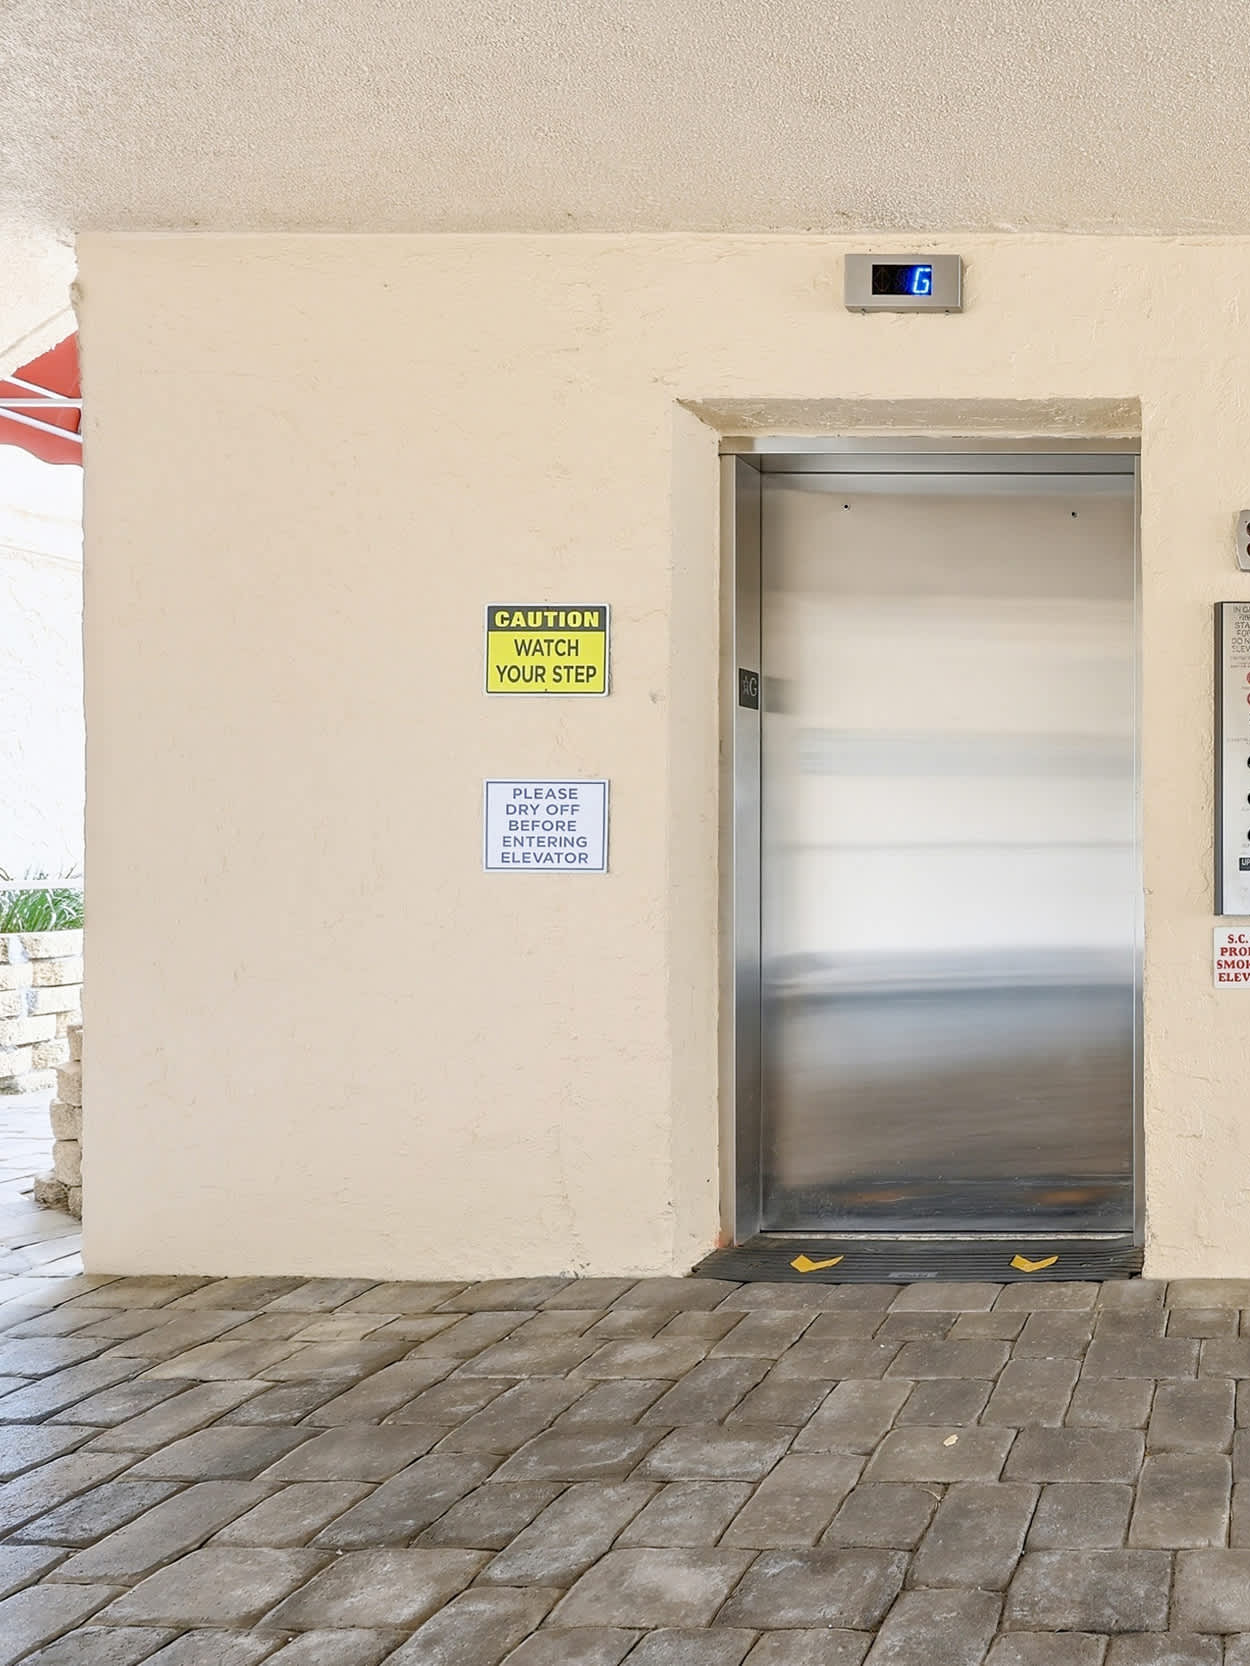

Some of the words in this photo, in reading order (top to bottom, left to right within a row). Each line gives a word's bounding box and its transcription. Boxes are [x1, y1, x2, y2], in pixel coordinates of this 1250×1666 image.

[912, 267, 931, 293] G
[495, 611, 599, 628] CAUTION
[514, 638, 579, 657] WATCH
[1231, 637, 1243, 645] DO
[496, 665, 546, 683] YOUR
[552, 665, 597, 683] STEP
[512, 787, 579, 800] PLEASE
[505, 803, 541, 816] DRY
[545, 803, 581, 816] OFF
[508, 819, 577, 832] BEFORE
[502, 835, 588, 848] ENTERING
[501, 851, 589, 864] ELEVATOR
[1227, 933, 1249, 944] S.C.
